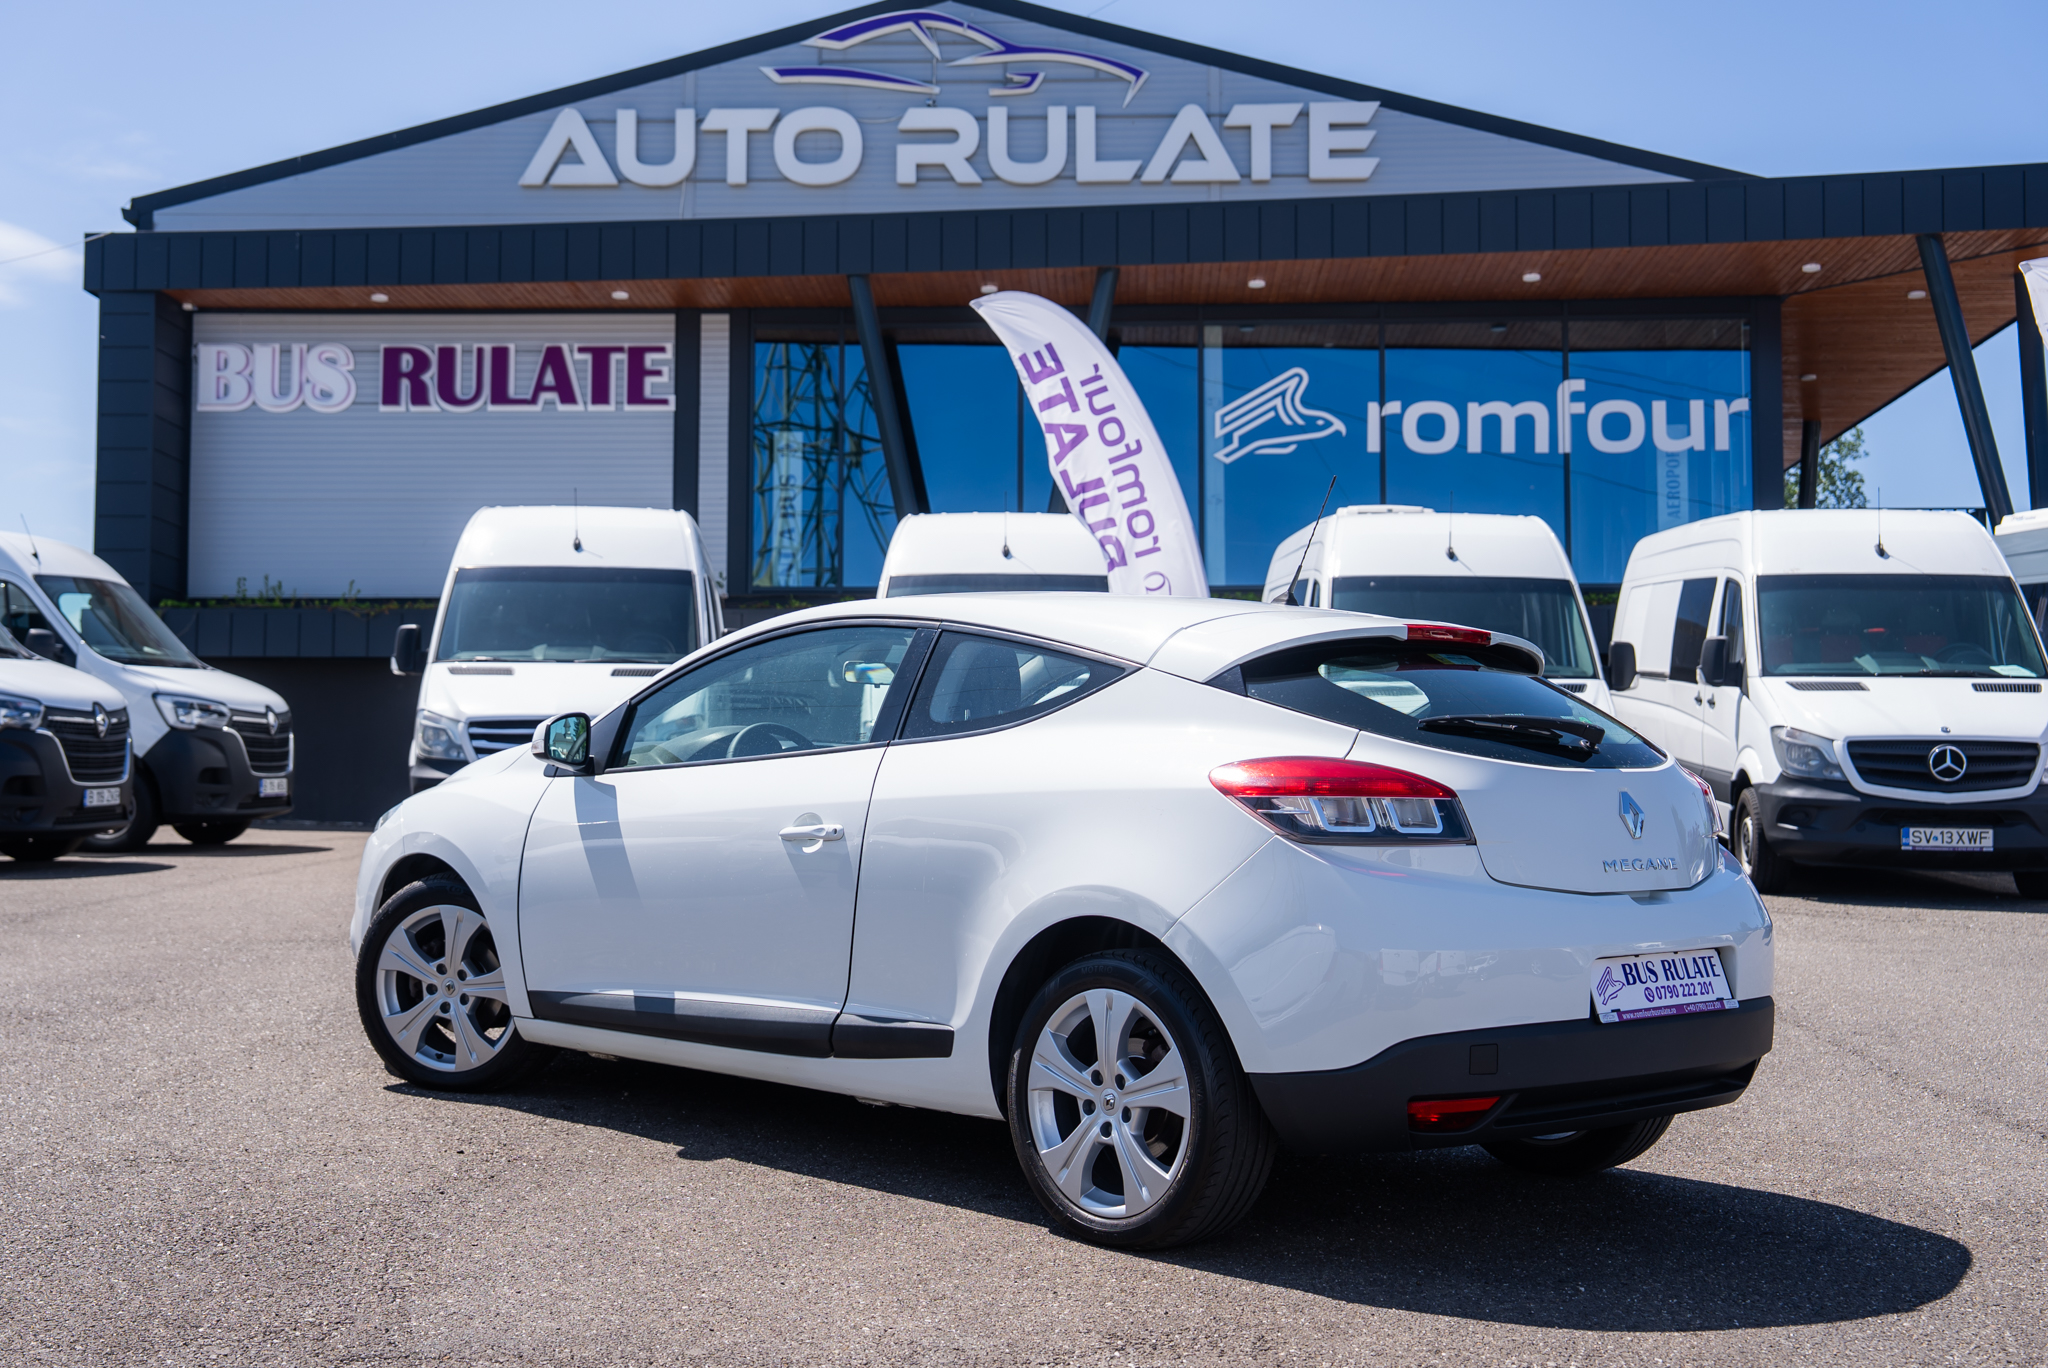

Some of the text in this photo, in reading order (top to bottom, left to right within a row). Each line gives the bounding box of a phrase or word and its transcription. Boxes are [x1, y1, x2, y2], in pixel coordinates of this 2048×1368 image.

[518, 101, 1382, 188] AUTO RULATE
[196, 342, 676, 414] BUS RULATE
[1366, 378, 1750, 454] romfour
[1911, 830, 1990, 845] SV 13 XWF
[1602, 857, 1679, 874] MEGANE
[1621, 956, 1721, 986] BUS RULATE
[1655, 980, 1715, 1000] 0790 222 201
